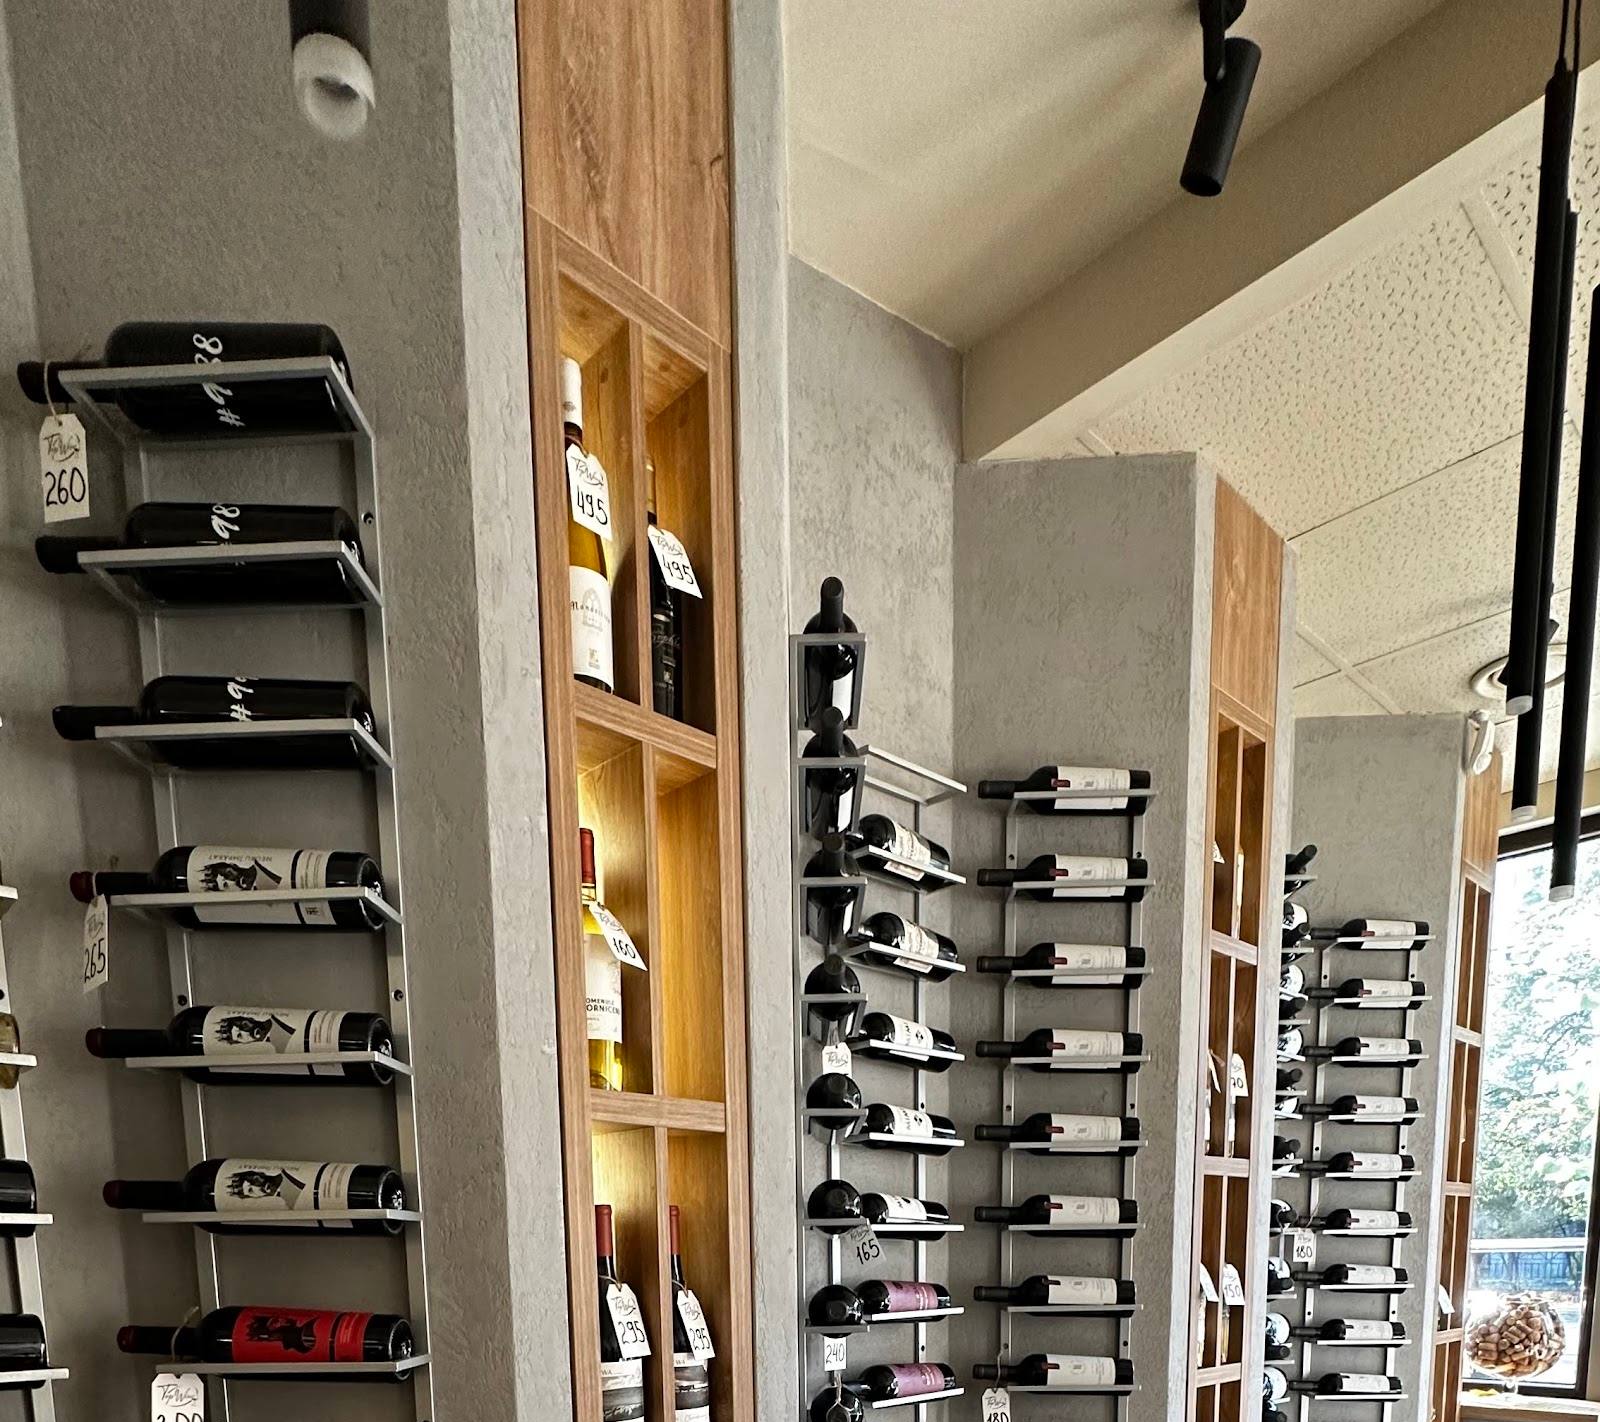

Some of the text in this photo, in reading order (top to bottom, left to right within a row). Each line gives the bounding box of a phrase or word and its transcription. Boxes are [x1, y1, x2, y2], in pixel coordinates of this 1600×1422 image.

[44, 467, 86, 506] 260
[577, 485, 608, 526] 495
[662, 553, 695, 586] 495
[83, 938, 107, 983] 265
[613, 938, 636, 960] 160
[856, 1239, 880, 1265] 165
[1296, 1245, 1313, 1258] 180
[618, 1320, 646, 1345] 295
[690, 1327, 710, 1352] 295
[825, 1342, 845, 1364] 240
